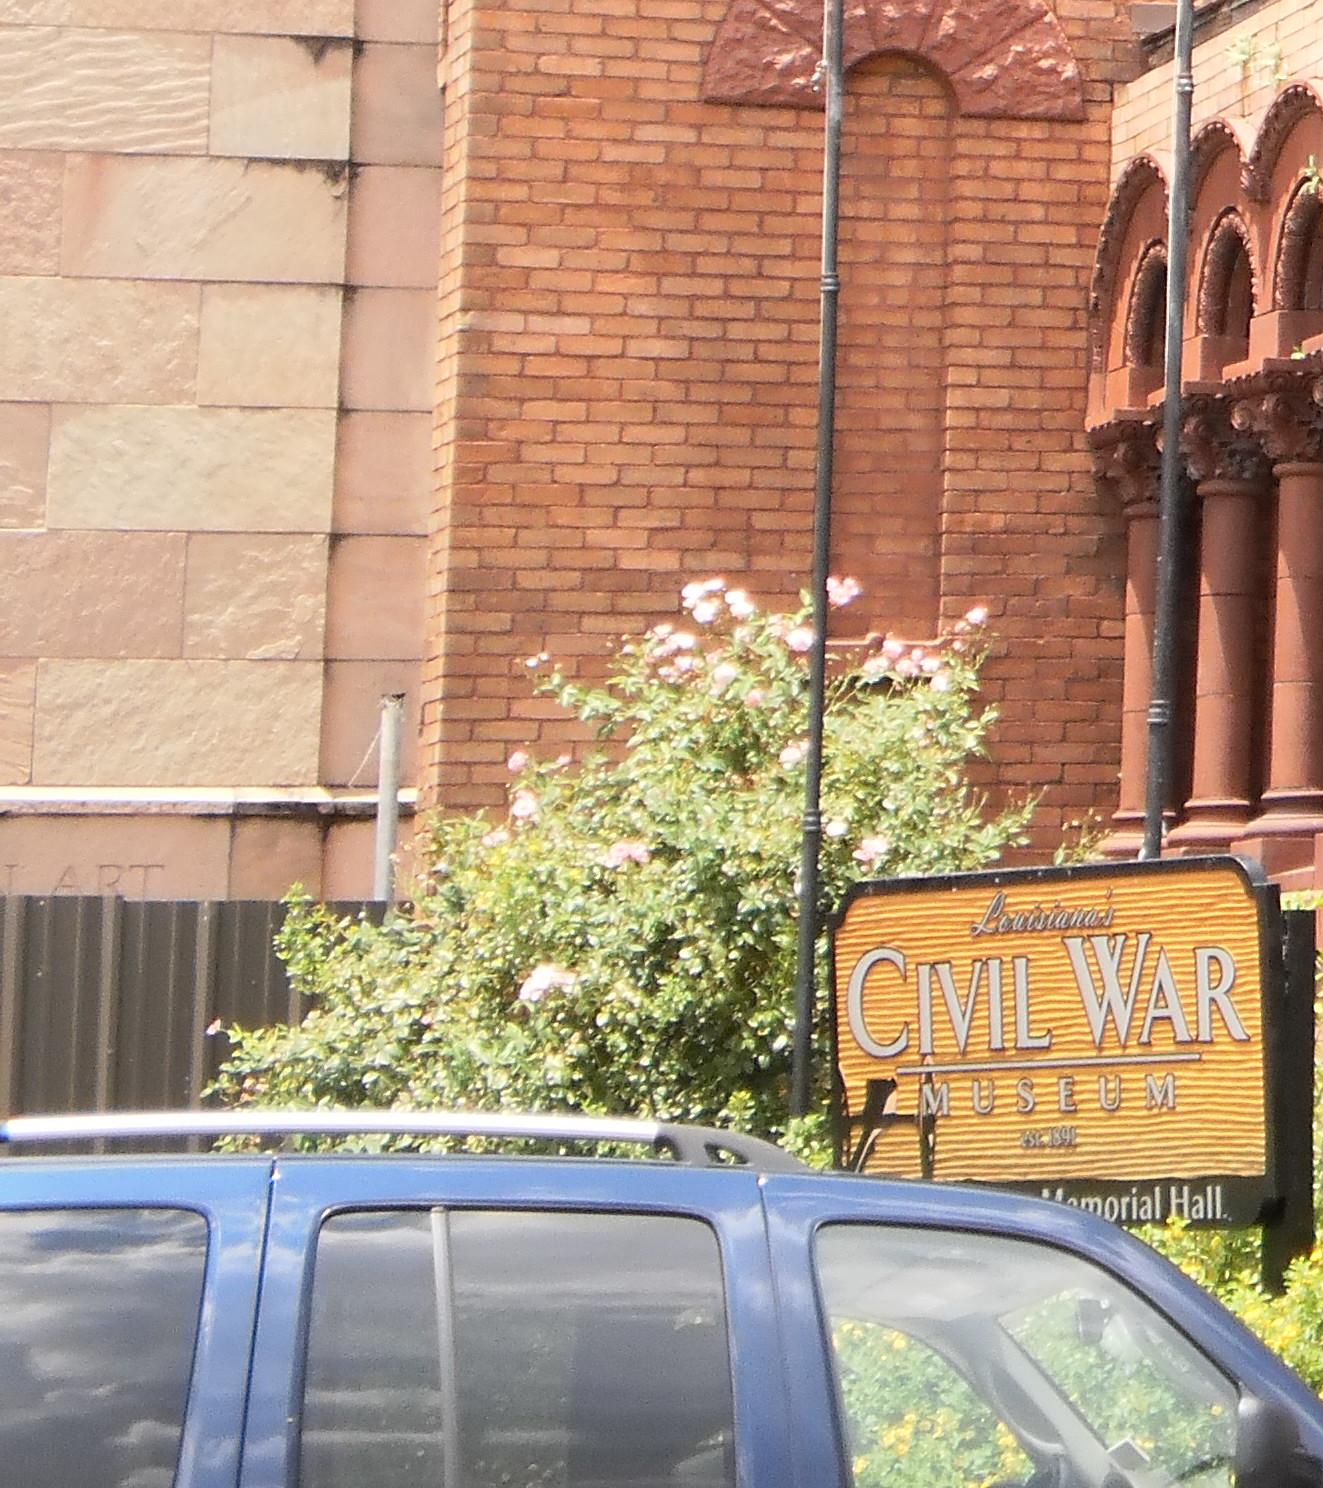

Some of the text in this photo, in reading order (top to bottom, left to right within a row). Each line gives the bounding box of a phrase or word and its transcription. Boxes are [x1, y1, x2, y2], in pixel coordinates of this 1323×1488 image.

[970, 887, 1115, 936] Louisiana's
[847, 932, 1251, 1059] CIVIL WAR
[921, 1072, 1177, 1116] MUSEUM
